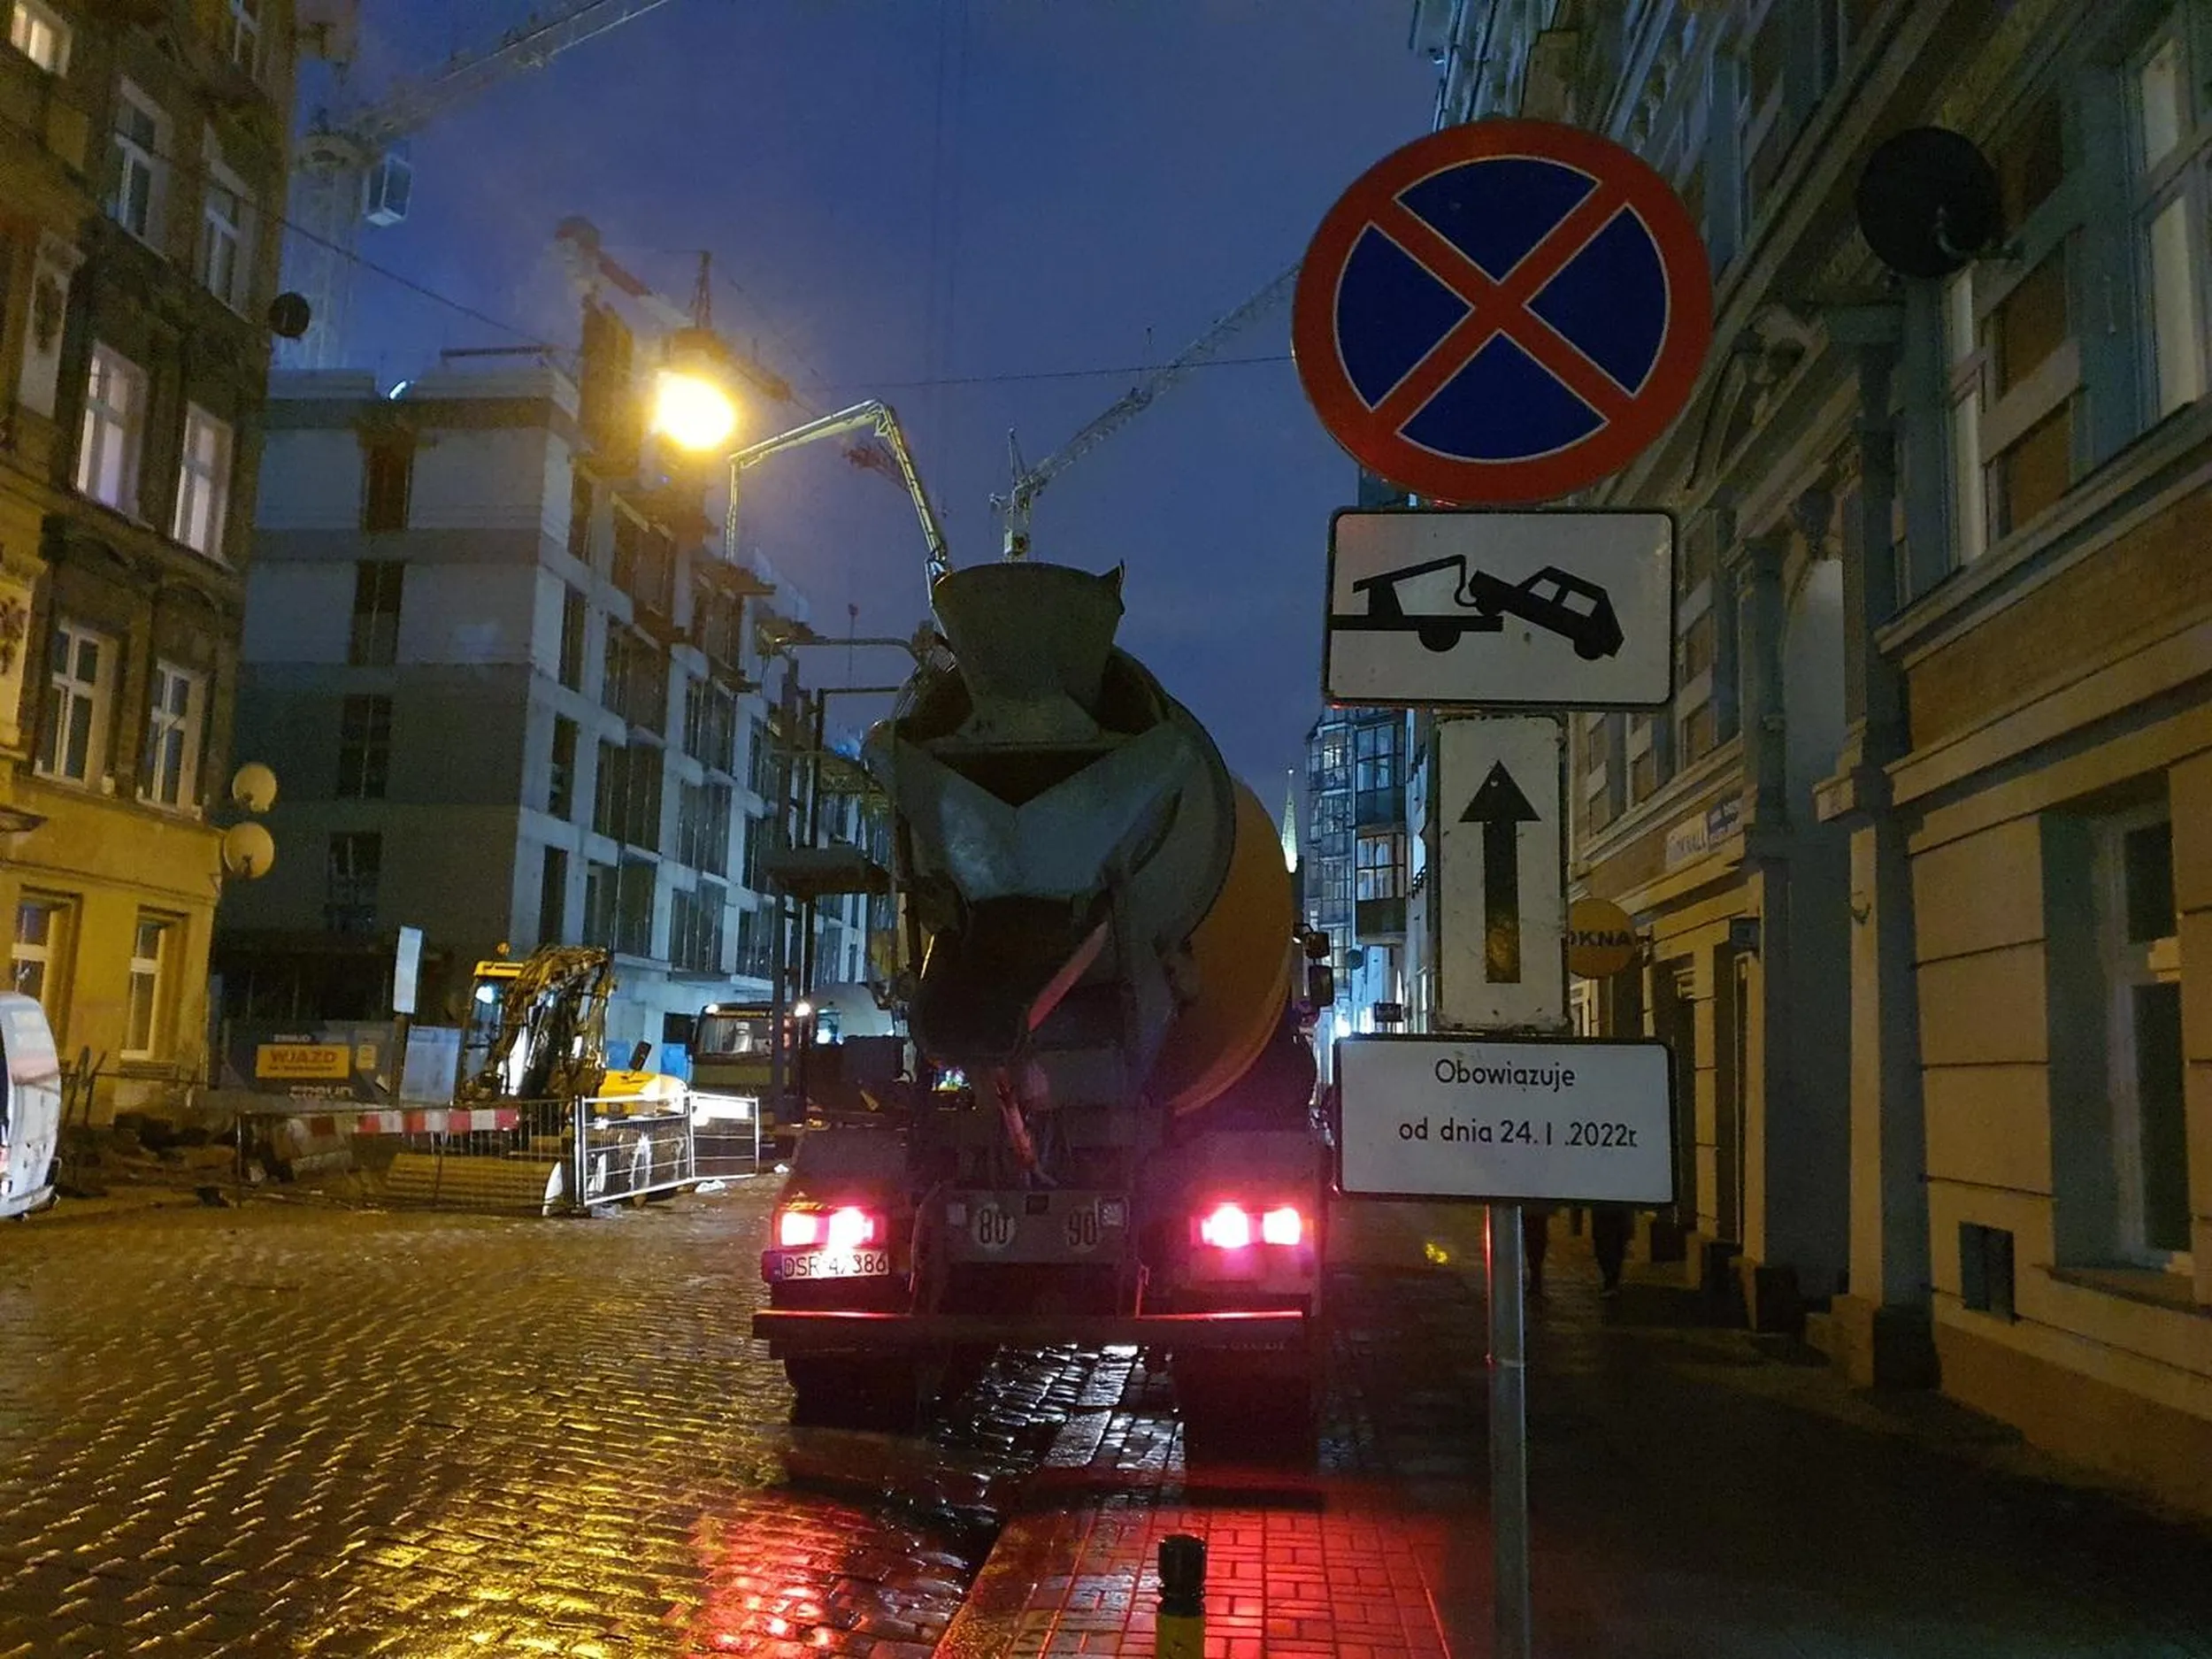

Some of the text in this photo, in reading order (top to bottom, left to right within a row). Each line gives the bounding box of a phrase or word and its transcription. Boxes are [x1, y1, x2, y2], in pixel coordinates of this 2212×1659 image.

[1434, 1058, 1575, 1093] Obowiązuje
[1399, 1117, 1428, 1141] od
[1440, 1117, 1493, 1143] dnia
[979, 1209, 1009, 1244] 80
[1068, 1210, 1098, 1246] 90
